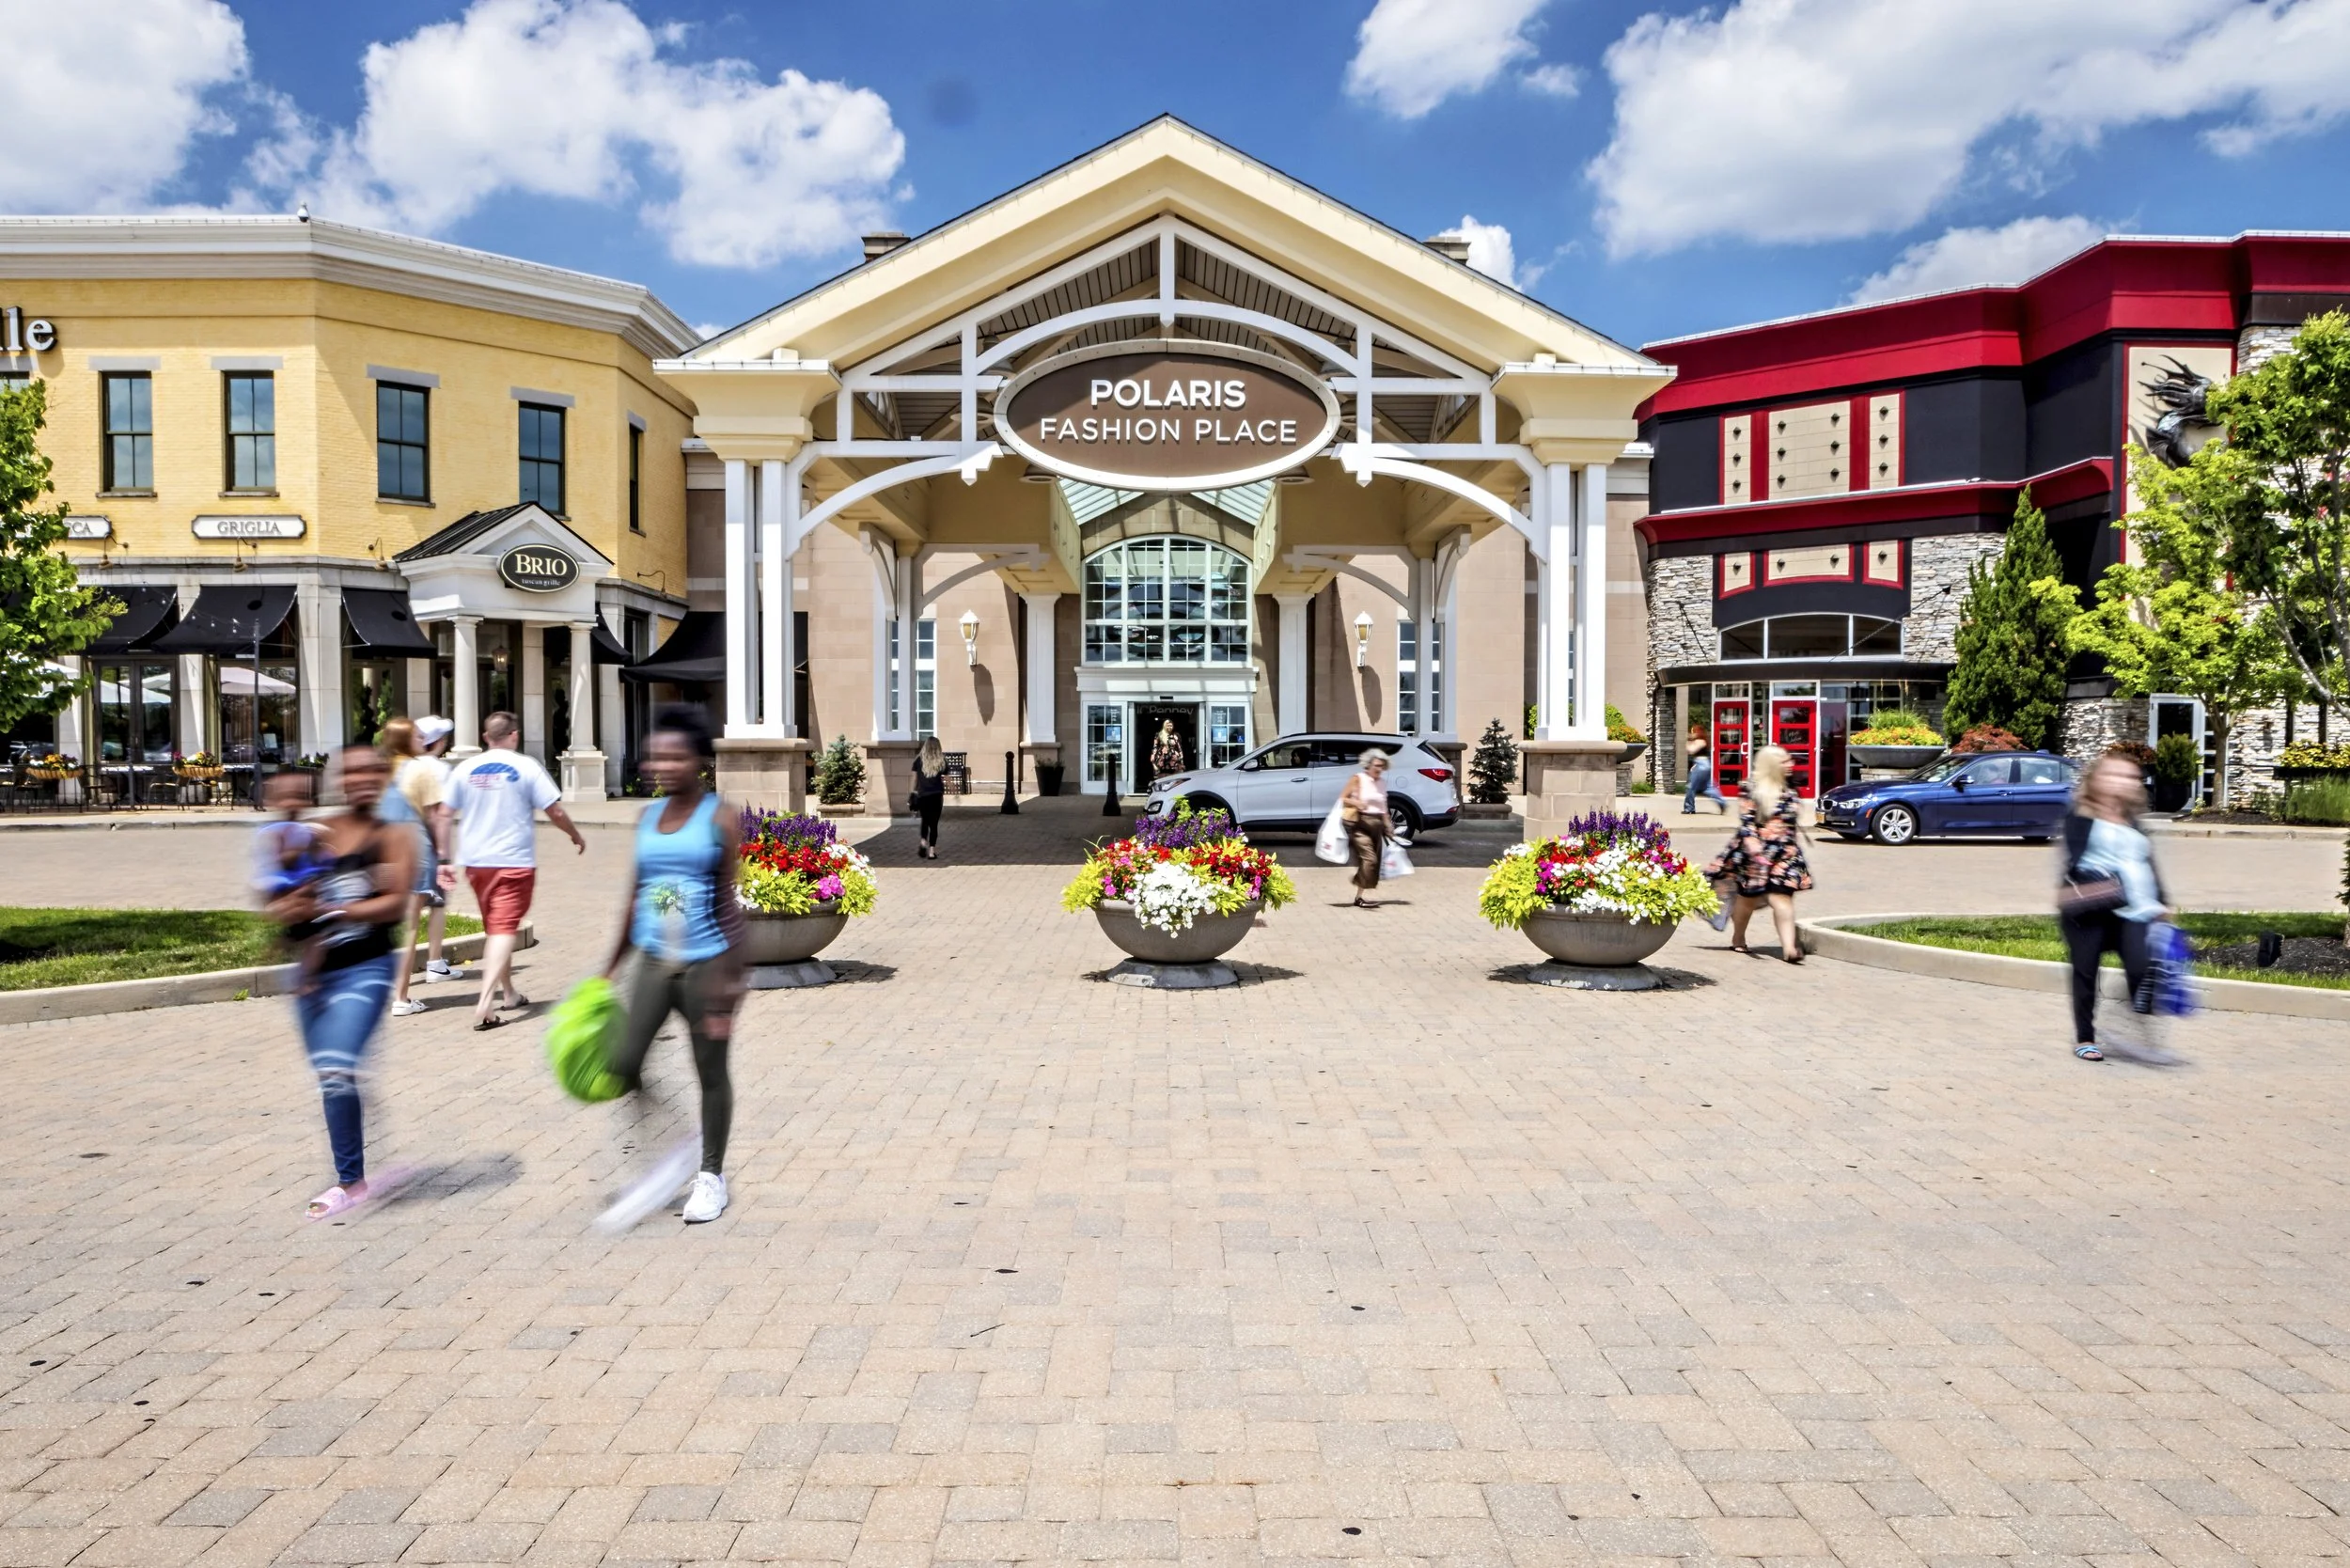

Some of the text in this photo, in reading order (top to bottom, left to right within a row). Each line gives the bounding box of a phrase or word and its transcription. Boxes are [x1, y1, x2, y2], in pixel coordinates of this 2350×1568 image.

[0, 306, 57, 352] le
[1091, 379, 1246, 409] POLARIS
[1040, 418, 1297, 443] FASHION PLACE
[217, 521, 282, 536] GRIGLIA
[514, 554, 568, 576] BRIO
